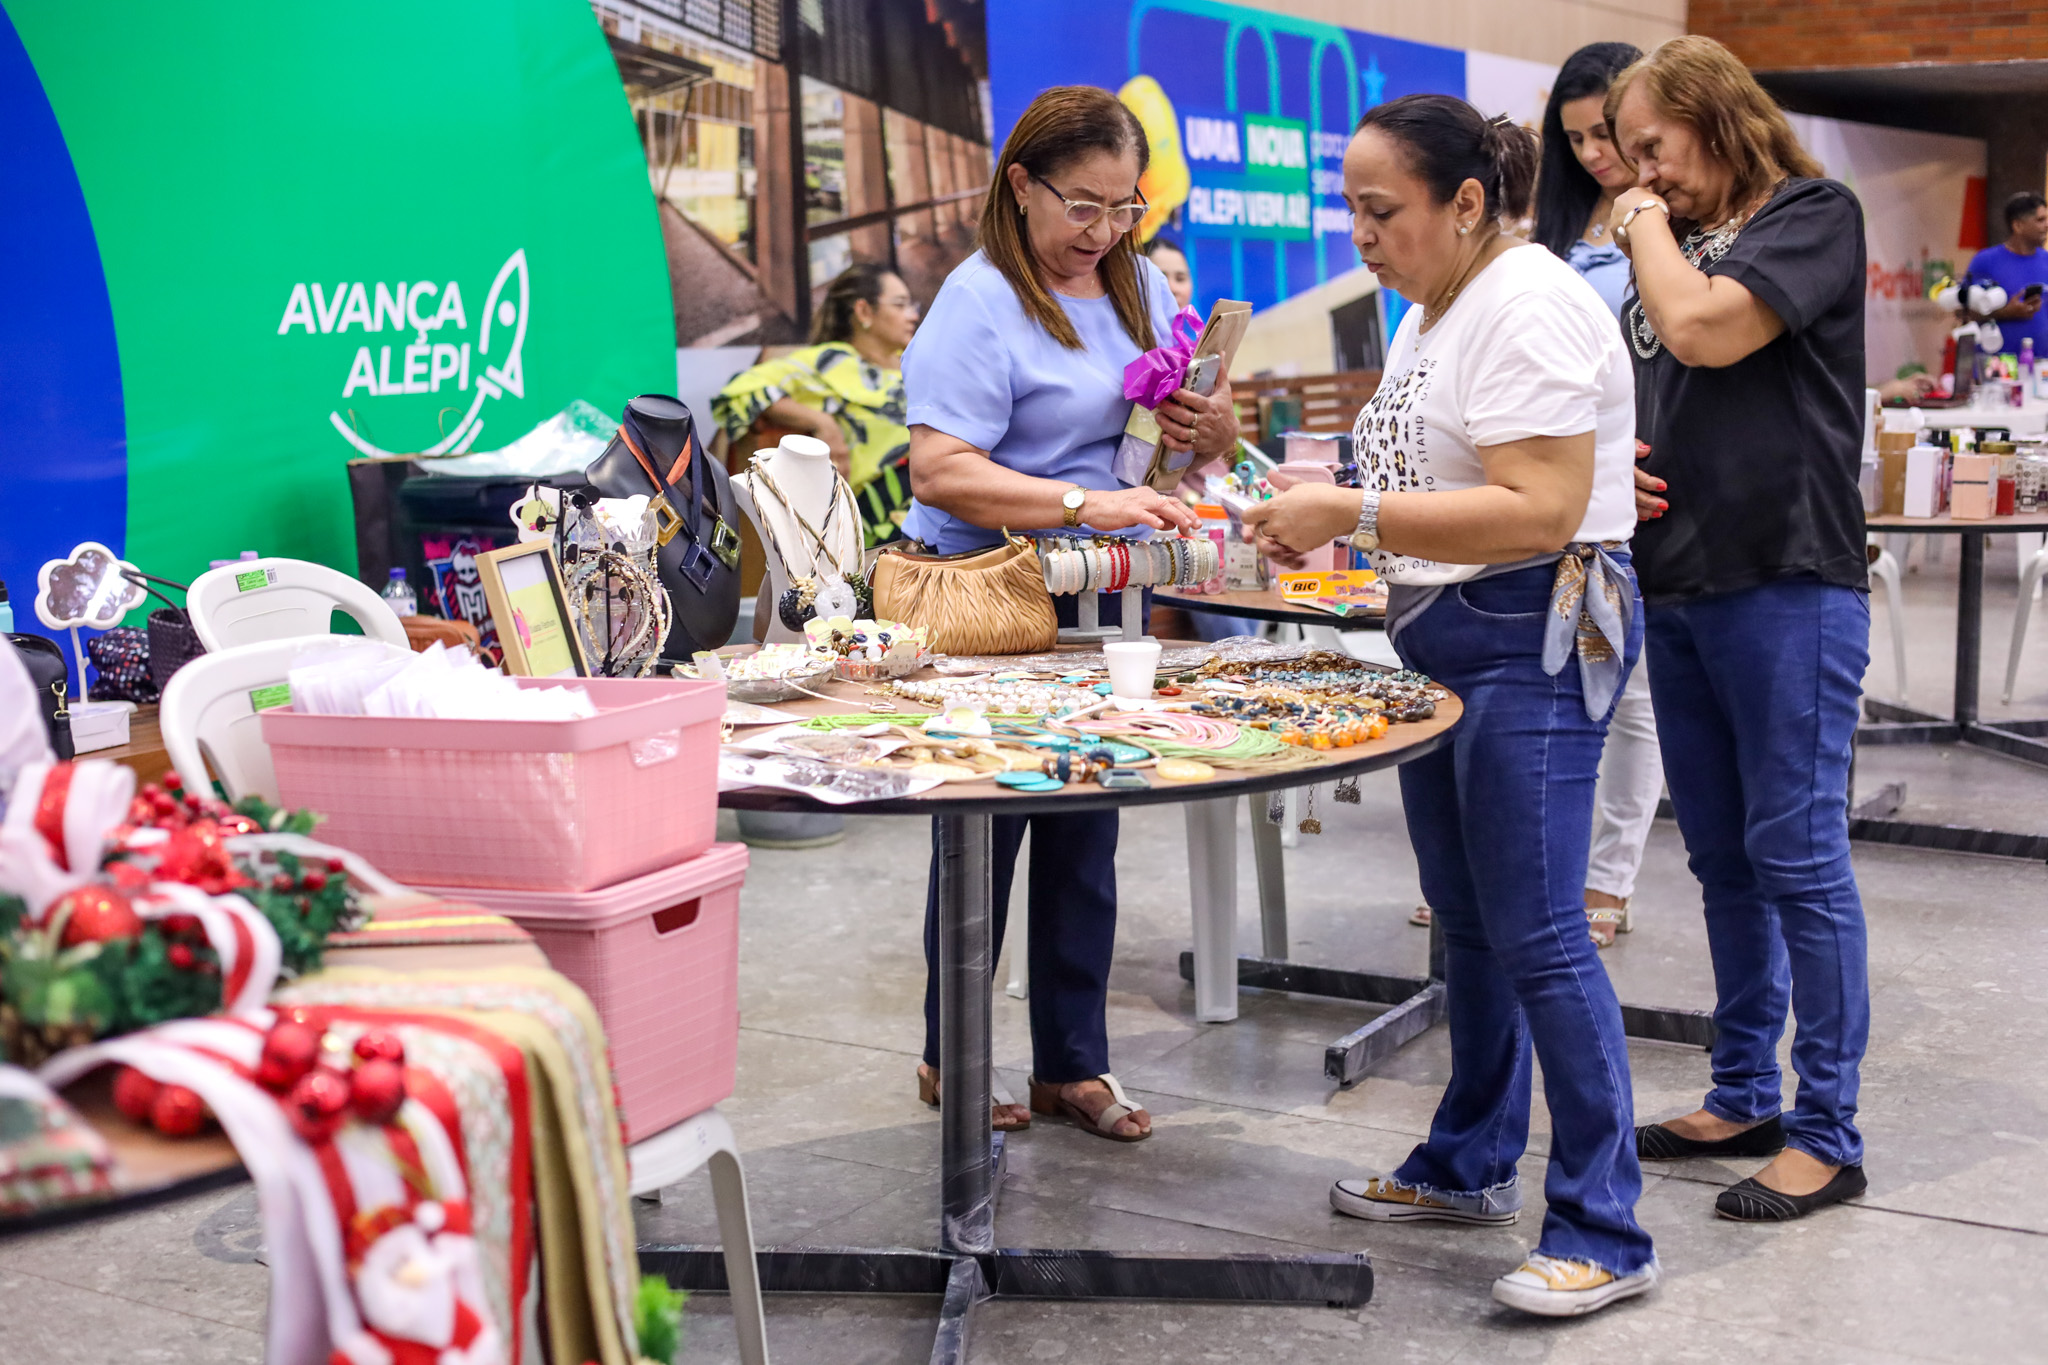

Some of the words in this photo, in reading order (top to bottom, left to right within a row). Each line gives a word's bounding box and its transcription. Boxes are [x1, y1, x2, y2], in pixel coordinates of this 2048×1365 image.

[1186, 115, 1241, 163] UMA
[1246, 190, 1286, 227] VEM
[277, 281, 468, 345] AVANÇA
[1415, 415, 1429, 463] STAND
[1424, 476, 1437, 492] TO
[1374, 563, 1406, 576] TAND
